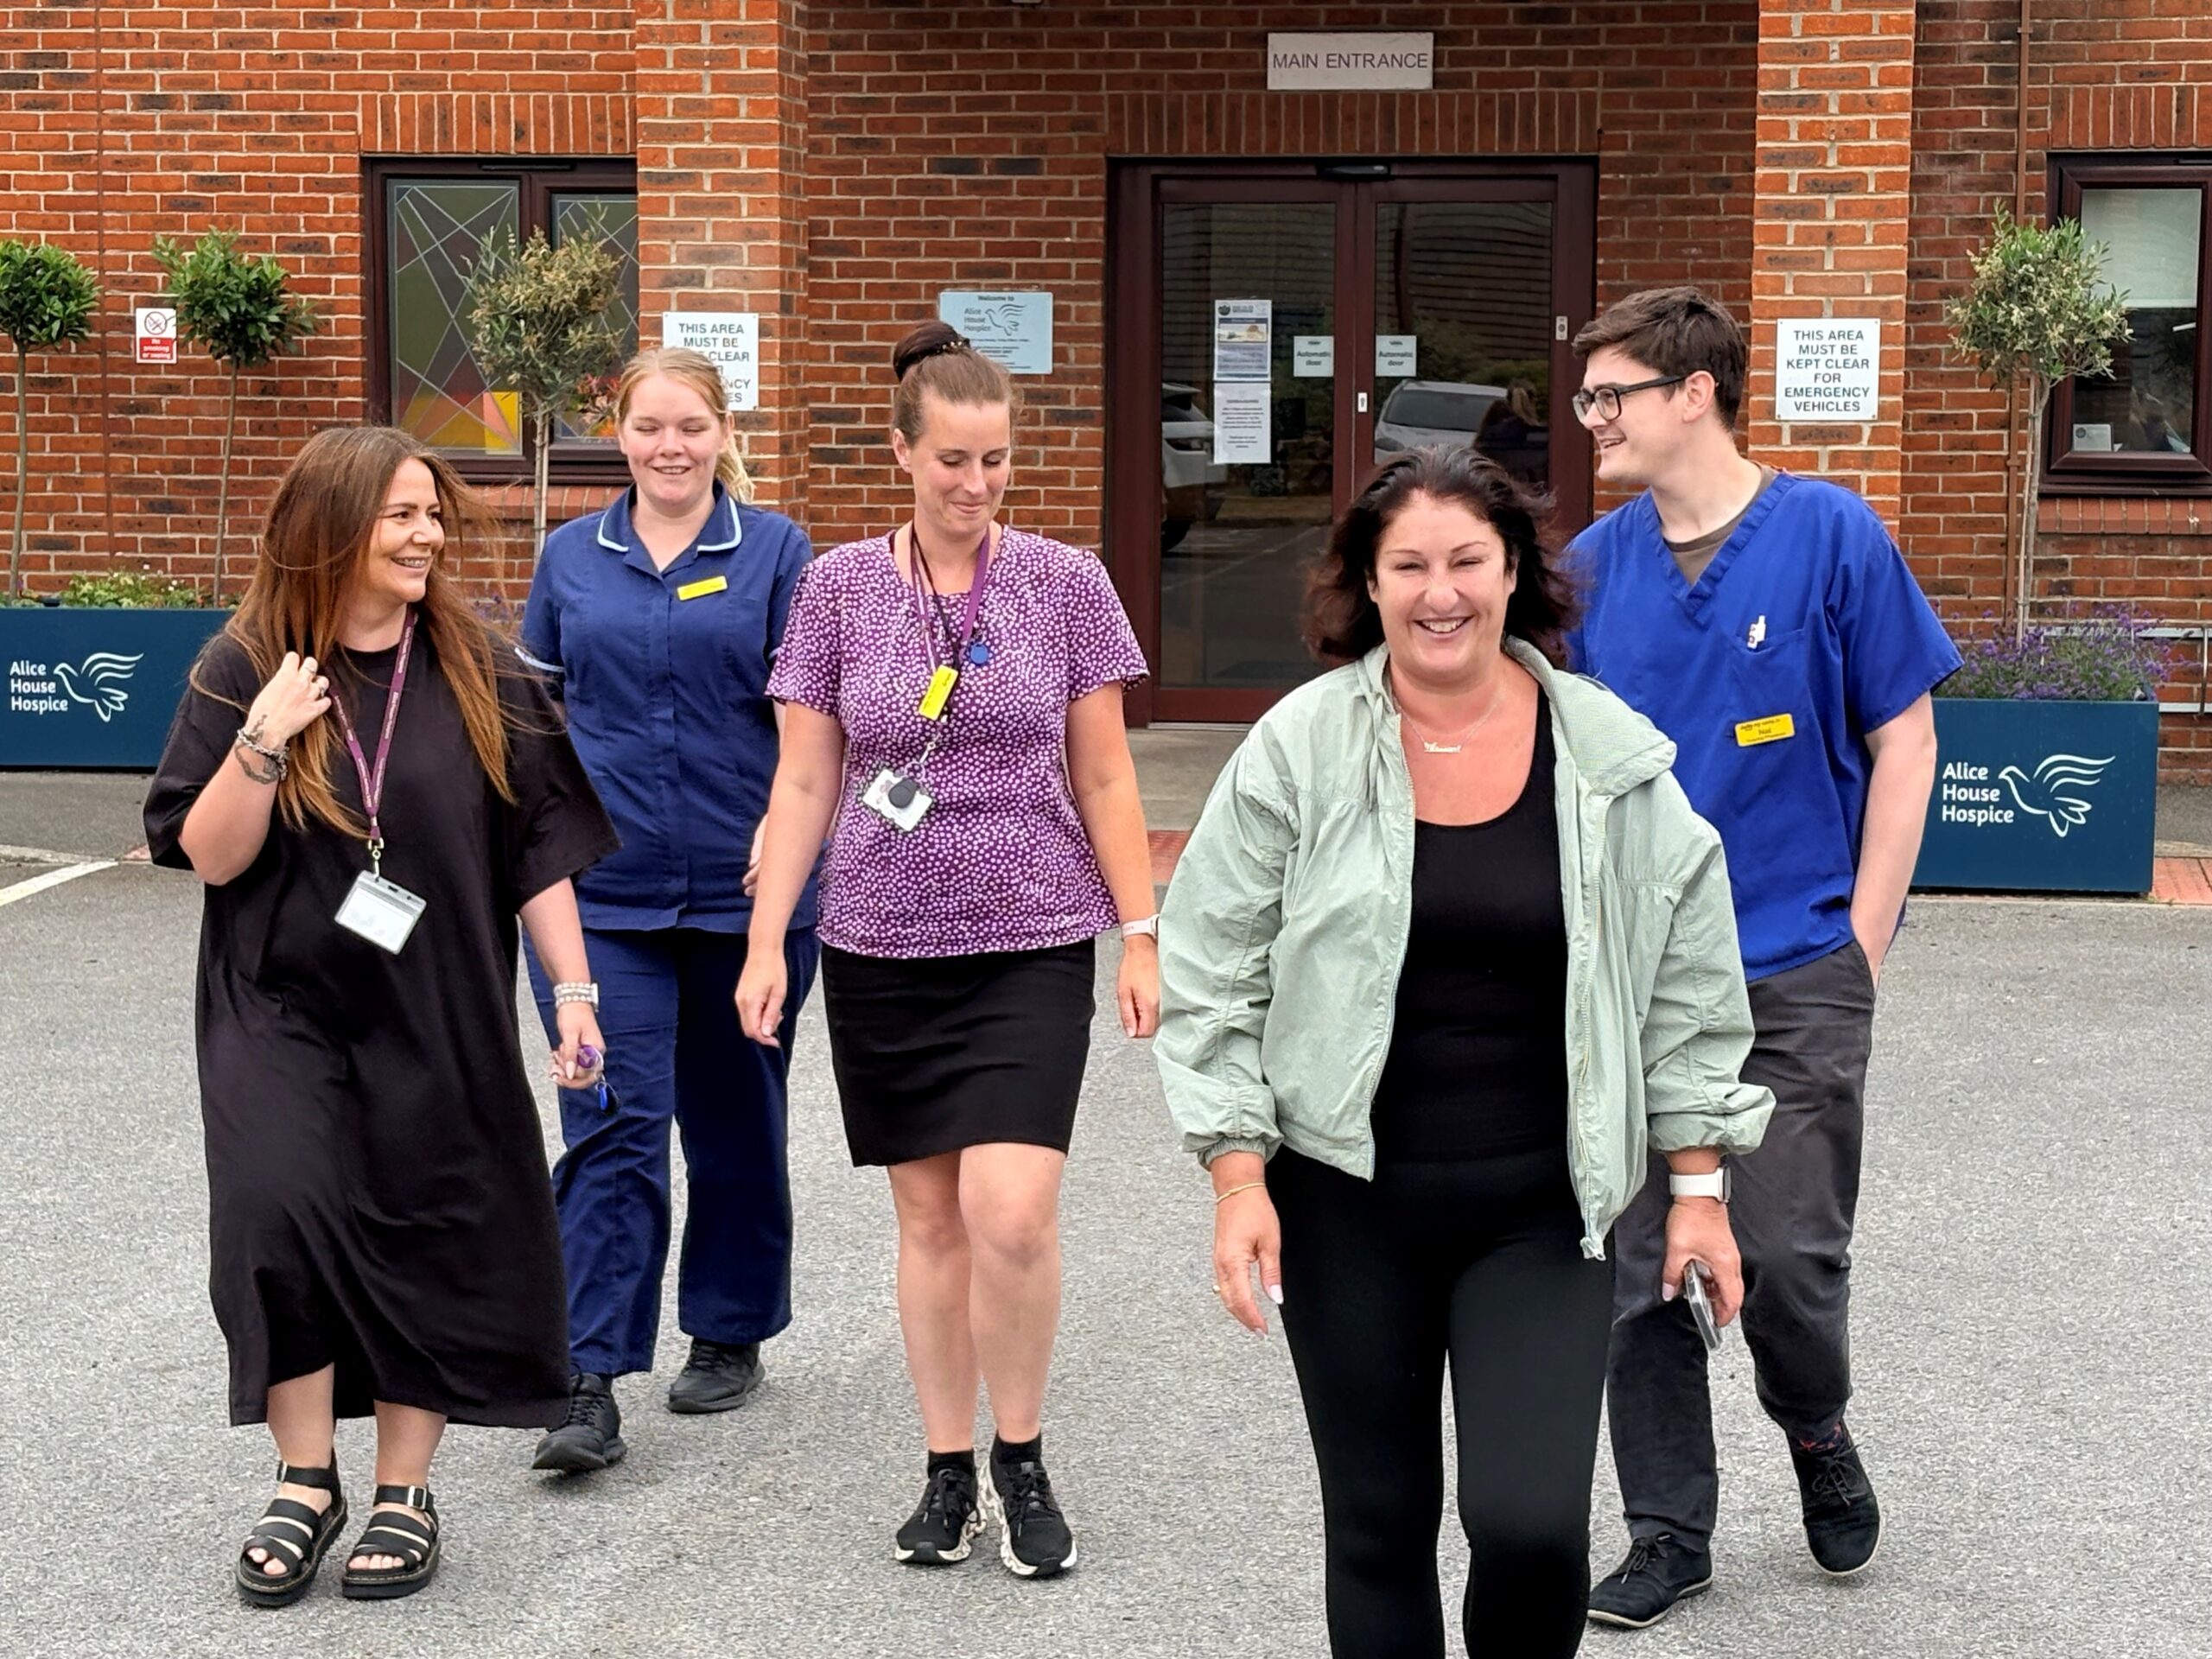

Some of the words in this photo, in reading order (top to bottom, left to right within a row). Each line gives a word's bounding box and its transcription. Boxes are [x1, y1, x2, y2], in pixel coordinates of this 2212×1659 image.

[1273, 54, 1318, 68] MAIN
[1325, 53, 1428, 68] ENTRANCE
[678, 323, 707, 334] THIS
[710, 324, 744, 334] AREA
[1794, 330, 1823, 340] THIS
[1828, 330, 1864, 340] AREA
[683, 337, 718, 347] MUST
[722, 338, 739, 347] BE
[1799, 344, 1836, 354] MUST
[1840, 344, 1858, 354] BE
[709, 351, 749, 362] CLEAR
[1786, 359, 1821, 369] KEPT
[1825, 359, 1870, 369] CLEAR
[1814, 372, 1841, 384] FOR
[1784, 387, 1870, 397] EMERGENCY
[1794, 401, 1860, 412] VEHICLES
[10, 660, 47, 676] Alice
[10, 678, 56, 693] House
[11, 696, 68, 715] Hospice
[1942, 761, 1988, 780] Alice
[1942, 783, 2000, 802] House
[1942, 804, 2014, 827] Hospice
